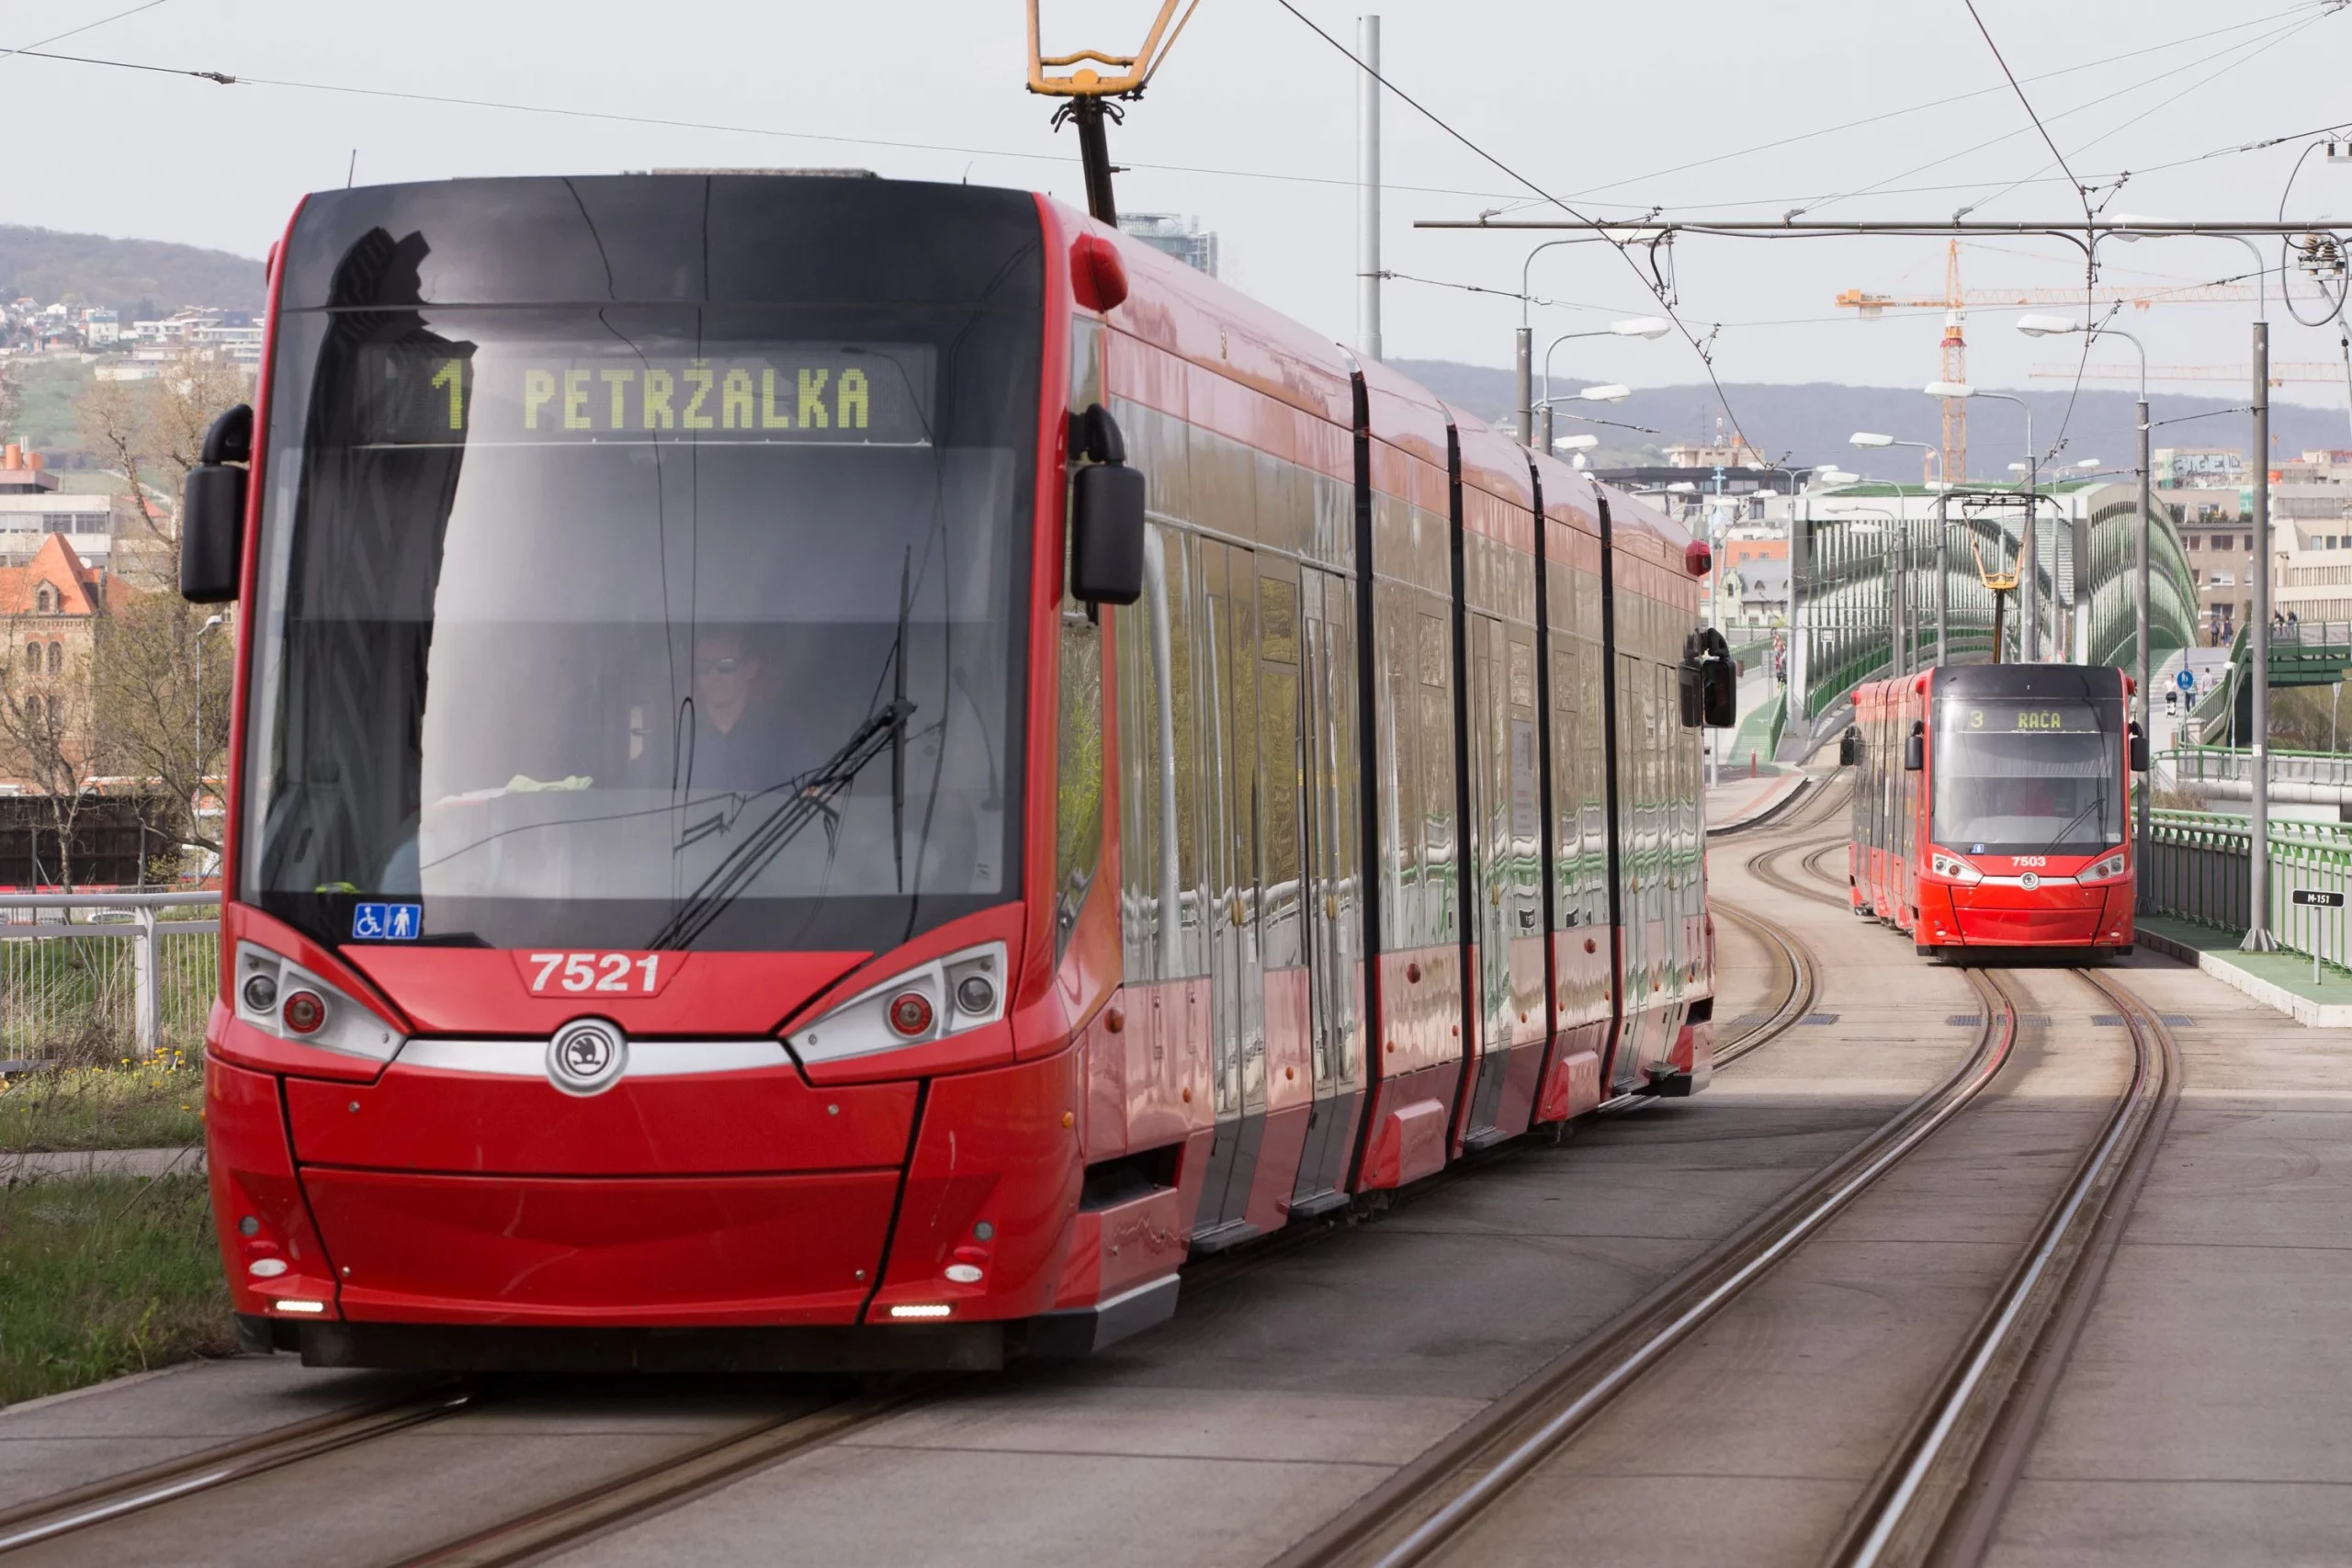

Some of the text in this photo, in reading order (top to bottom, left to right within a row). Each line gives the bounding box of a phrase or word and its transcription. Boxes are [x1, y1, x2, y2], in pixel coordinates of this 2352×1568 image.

[432, 358, 868, 430] 1 PETRŽALKA
[1970, 709, 2061, 728] 3 RAČA
[2011, 856, 2047, 867] 7503
[2307, 893, 2330, 904] M-151
[530, 953, 660, 993] 7521
